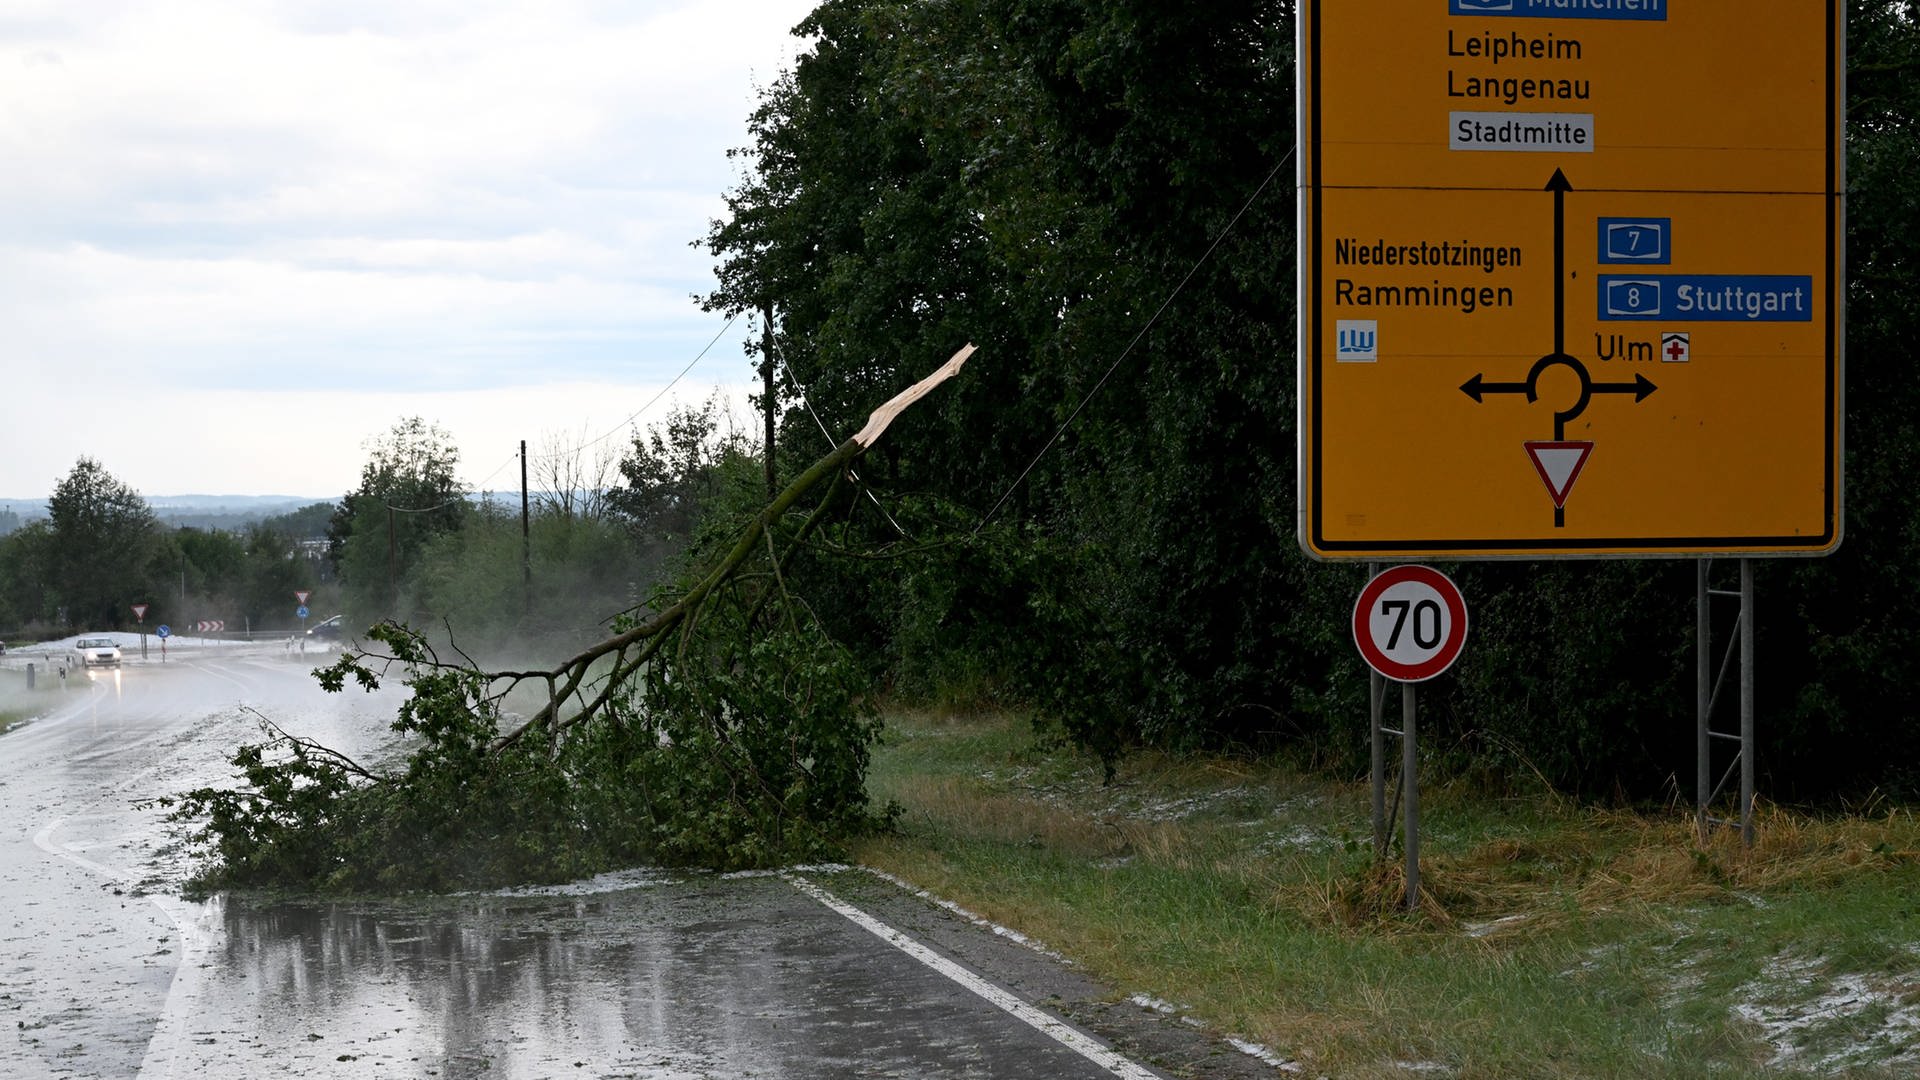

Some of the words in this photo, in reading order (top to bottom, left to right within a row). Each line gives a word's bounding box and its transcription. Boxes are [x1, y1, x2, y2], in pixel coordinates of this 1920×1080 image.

[1448, 30, 1582, 65] Leipheim
[1447, 70, 1590, 105] Langenau
[1457, 120, 1586, 144] Stadtmitte
[1335, 239, 1521, 274] Niederstotzingen
[1628, 231, 1640, 251] 7
[1335, 279, 1513, 314] Rammingen
[1628, 287, 1640, 308] 8
[1676, 285, 1803, 319] Stuttgart
[1596, 334, 1653, 362] Ulm
[1381, 599, 1442, 650] 70
